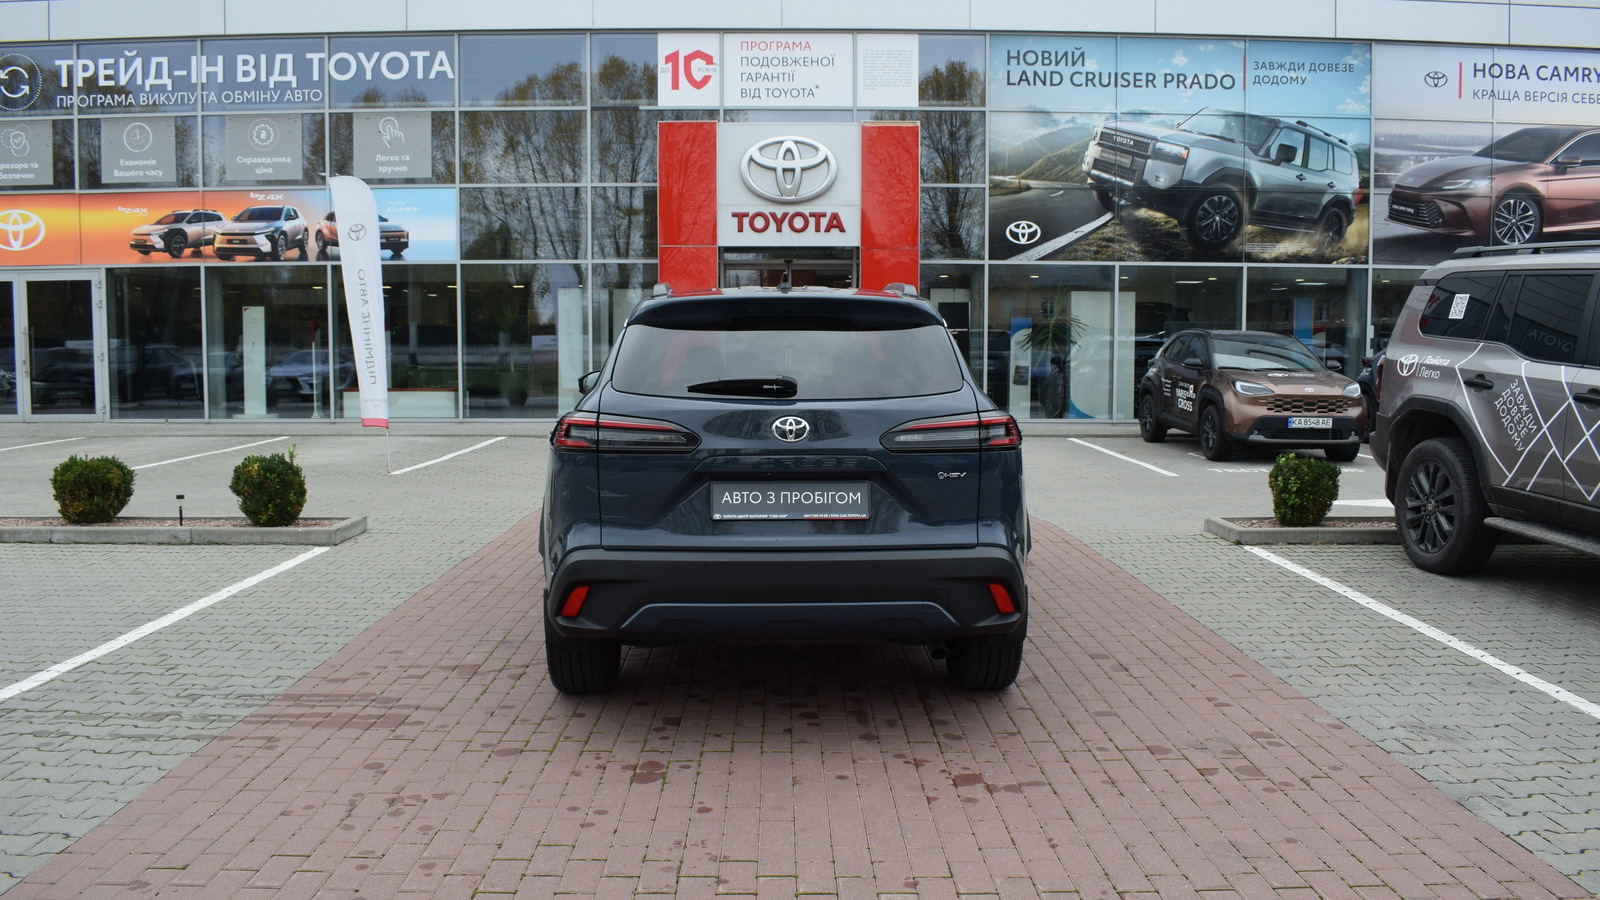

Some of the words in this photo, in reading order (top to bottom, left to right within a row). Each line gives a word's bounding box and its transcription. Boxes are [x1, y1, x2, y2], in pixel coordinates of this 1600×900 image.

[740, 41, 812, 52] ПРОГРАМА
[740, 54, 836, 69] ПОДОВЖЕНОЇ
[1006, 46, 1086, 67] НОВИЙ
[54, 50, 224, 91] ТРЕЙД-ІН
[236, 53, 297, 88] ВІД
[305, 50, 455, 81] TOYOTA
[1252, 61, 1305, 73] ЗАВЖДИ
[1308, 62, 1354, 73] ДОВЕЗЕ
[1473, 62, 1530, 80] НОВА
[1535, 64, 1600, 83] CAMRY
[740, 69, 796, 83] ГАРАНТІЇ
[1006, 69, 1064, 87] LAND
[1069, 71, 1157, 89] CRUISER
[1163, 73, 1236, 90] PRADO
[1252, 74, 1307, 86] ДОДОМУ
[56, 93, 136, 108] ПРОГРАМА
[139, 92, 197, 106] ВИКУПУ
[201, 91, 218, 104] ТА
[221, 90, 281, 104] ОБМІНУ
[283, 88, 323, 102] АВТО
[740, 87, 762, 100] ВІД
[1472, 88, 1521, 103] КРАЩА
[1524, 90, 1568, 103] ВЕРСІЯ
[1571, 92, 1600, 105] СЕБЕ
[1113, 135, 1134, 146] TOYOTA
[119, 158, 157, 167] Економія
[236, 155, 292, 164] Справедлива
[375, 153, 399, 163] Легко
[113, 169, 144, 177] Вашого
[145, 169, 164, 178] часу
[255, 166, 273, 175] ціна
[377, 165, 408, 174] зручно
[731, 211, 846, 233] TOYOTA
[1424, 355, 1451, 366] Тойота
[1419, 366, 1441, 379] Легко
[1511, 379, 1538, 434] ЗАВЖДИ
[1501, 388, 1529, 439] ДОВЕЗЕ
[1292, 418, 1303, 427] KA
[1303, 418, 1320, 427] 8548
[1321, 418, 1331, 427] AE
[1494, 397, 1525, 451] ДОДОМУ
[721, 491, 763, 504] АВТО
[766, 491, 776, 504] З
[780, 491, 861, 504] ПРОБІГОМ
